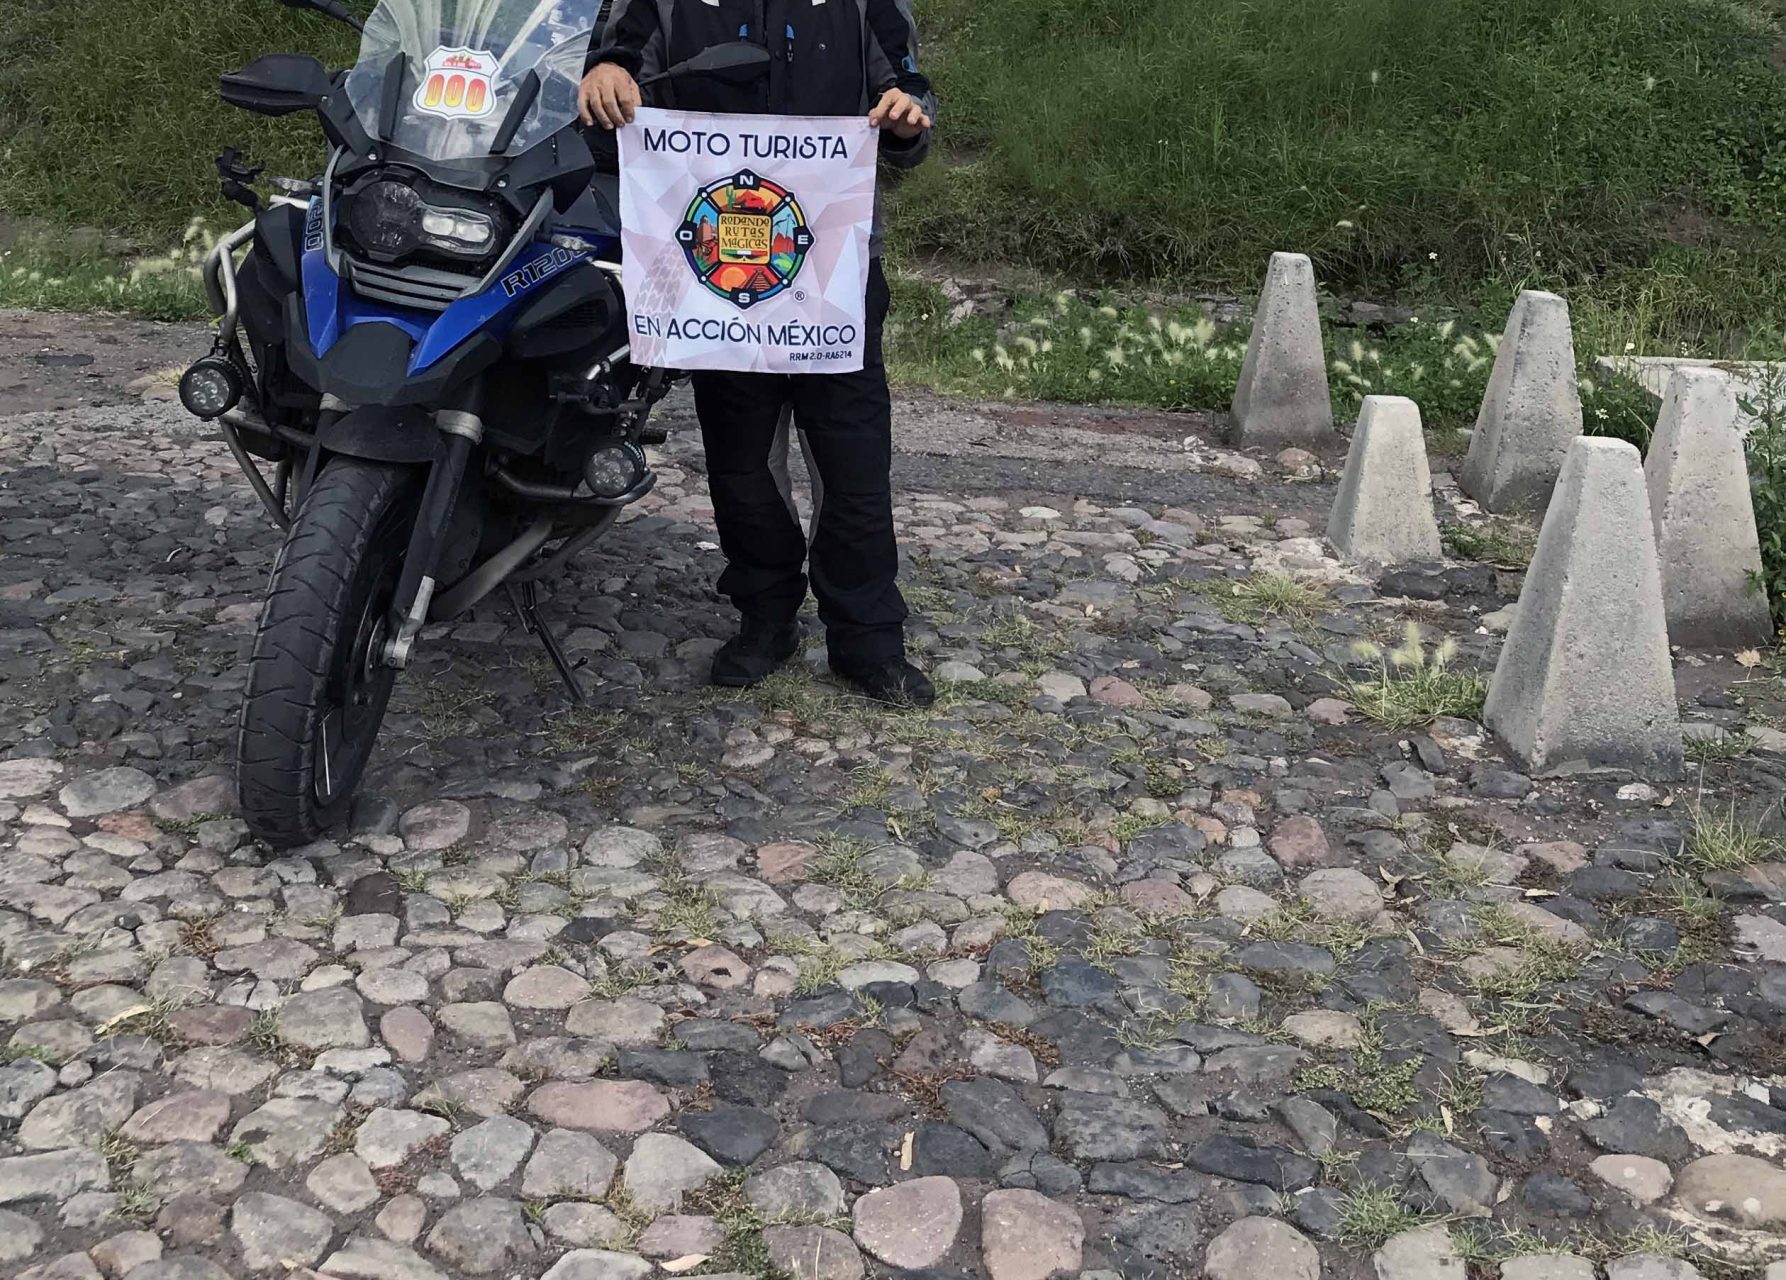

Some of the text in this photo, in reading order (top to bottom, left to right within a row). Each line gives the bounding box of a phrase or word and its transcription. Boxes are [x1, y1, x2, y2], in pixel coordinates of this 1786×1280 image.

[643, 127, 848, 160] MOTO TURISTA
[740, 175, 754, 185] N
[680, 232, 693, 241] O
[797, 235, 809, 245] E
[738, 293, 751, 303] S
[634, 314, 856, 347] EN ACCIÓN MÉXICO
